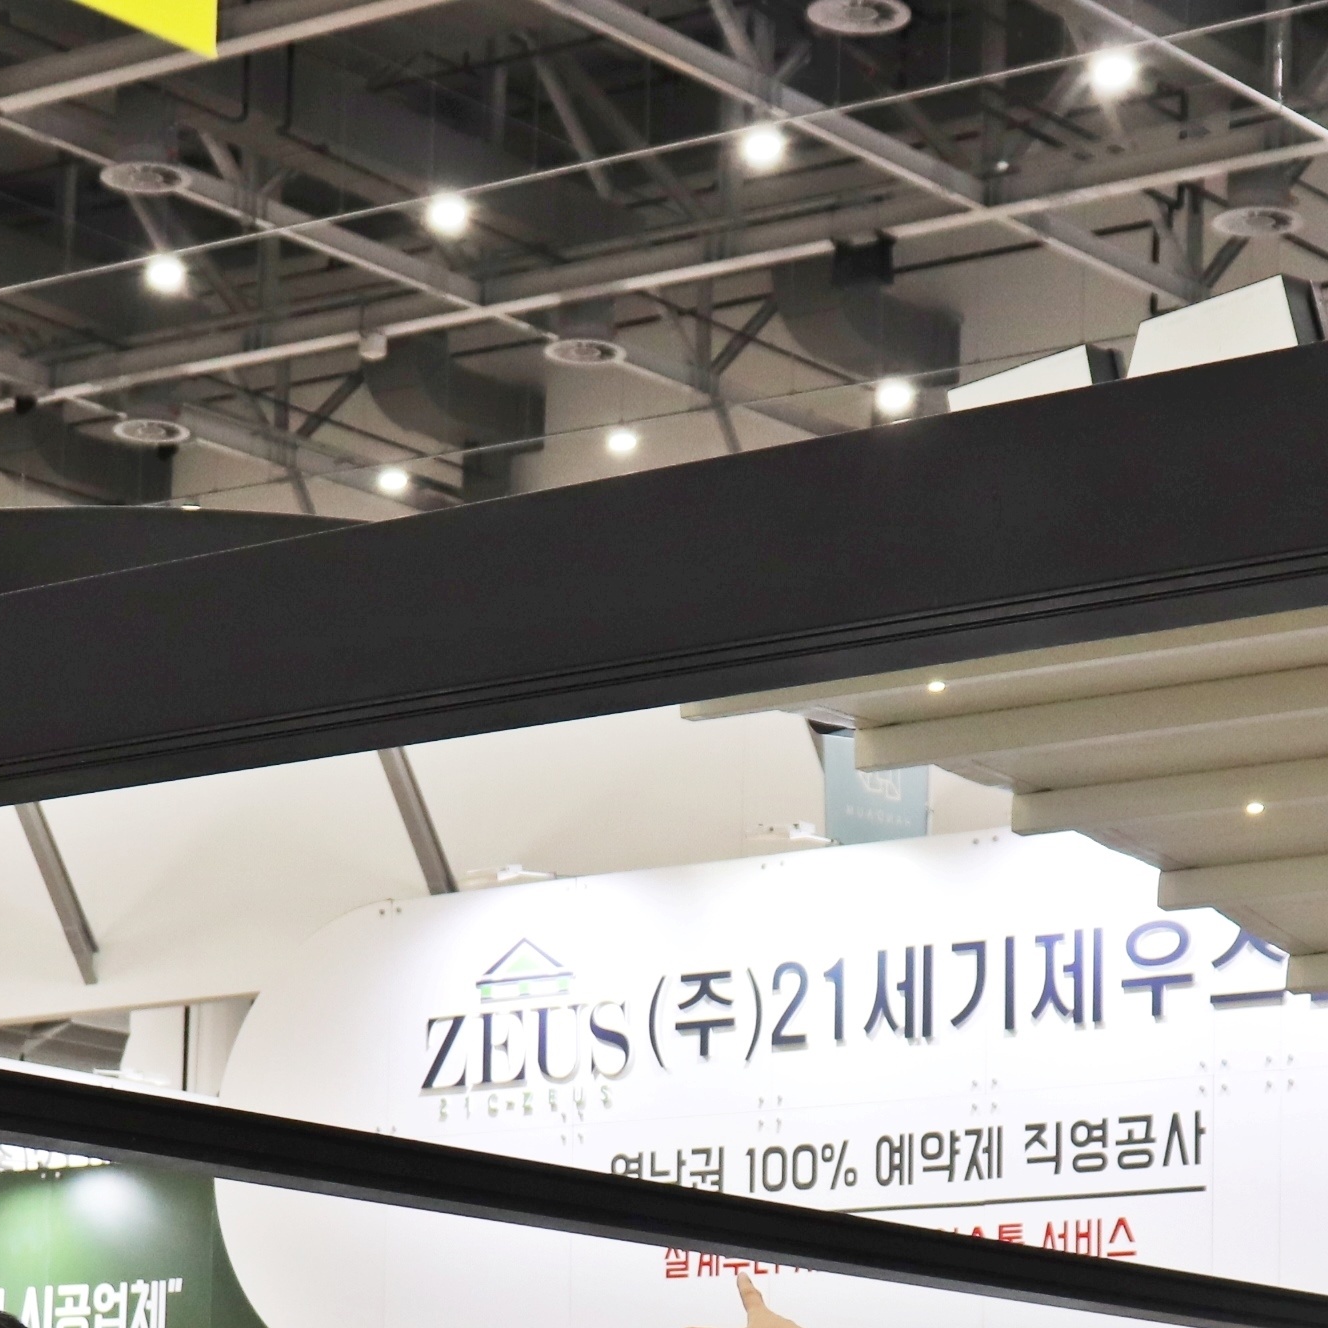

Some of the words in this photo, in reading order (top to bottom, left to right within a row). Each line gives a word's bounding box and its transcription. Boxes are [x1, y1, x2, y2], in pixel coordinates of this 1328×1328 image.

[421, 1000, 634, 1094] ZEUS
[745, 1139, 859, 1193] 100%
[875, 1124, 1004, 1187] 예약제
[1024, 1110, 1207, 1175] 직영공사
